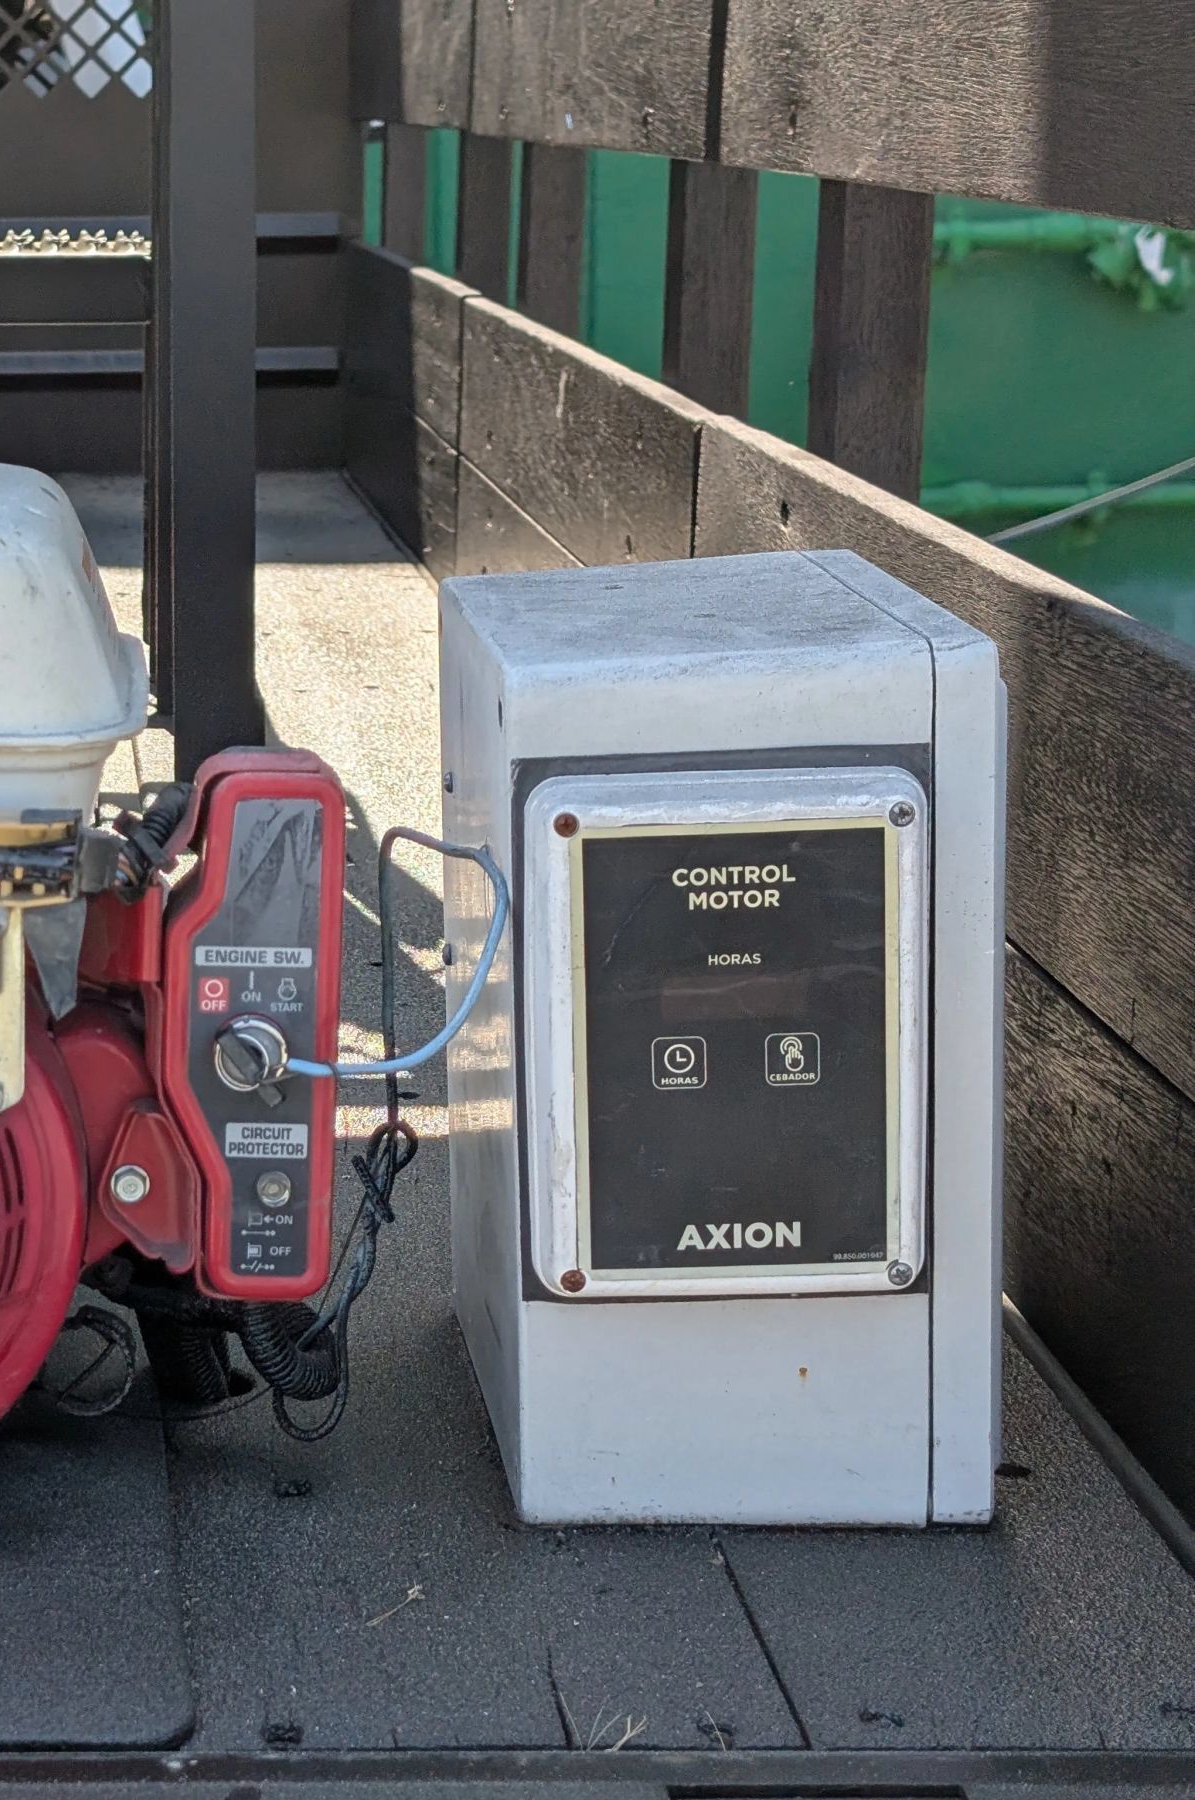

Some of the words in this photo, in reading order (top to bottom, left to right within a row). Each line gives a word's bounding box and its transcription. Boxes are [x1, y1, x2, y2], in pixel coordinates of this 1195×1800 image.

[672, 864, 796, 887] CONTROL
[688, 889, 780, 910] MOTOR
[204, 949, 268, 964] ENGINE
[273, 950, 304, 965] SW.
[708, 953, 762, 966] HORAS
[241, 991, 261, 1002] ON
[201, 1000, 227, 1011] OFF
[270, 1002, 303, 1012] START
[661, 1076, 699, 1085] HORAS
[769, 1072, 816, 1082] CEBADOR
[241, 1127, 292, 1140] CIRCUIT
[228, 1142, 304, 1156] PROTECTOR
[275, 1215, 293, 1225] ON
[676, 1221, 801, 1250] AXION
[269, 1246, 292, 1256] OFF
